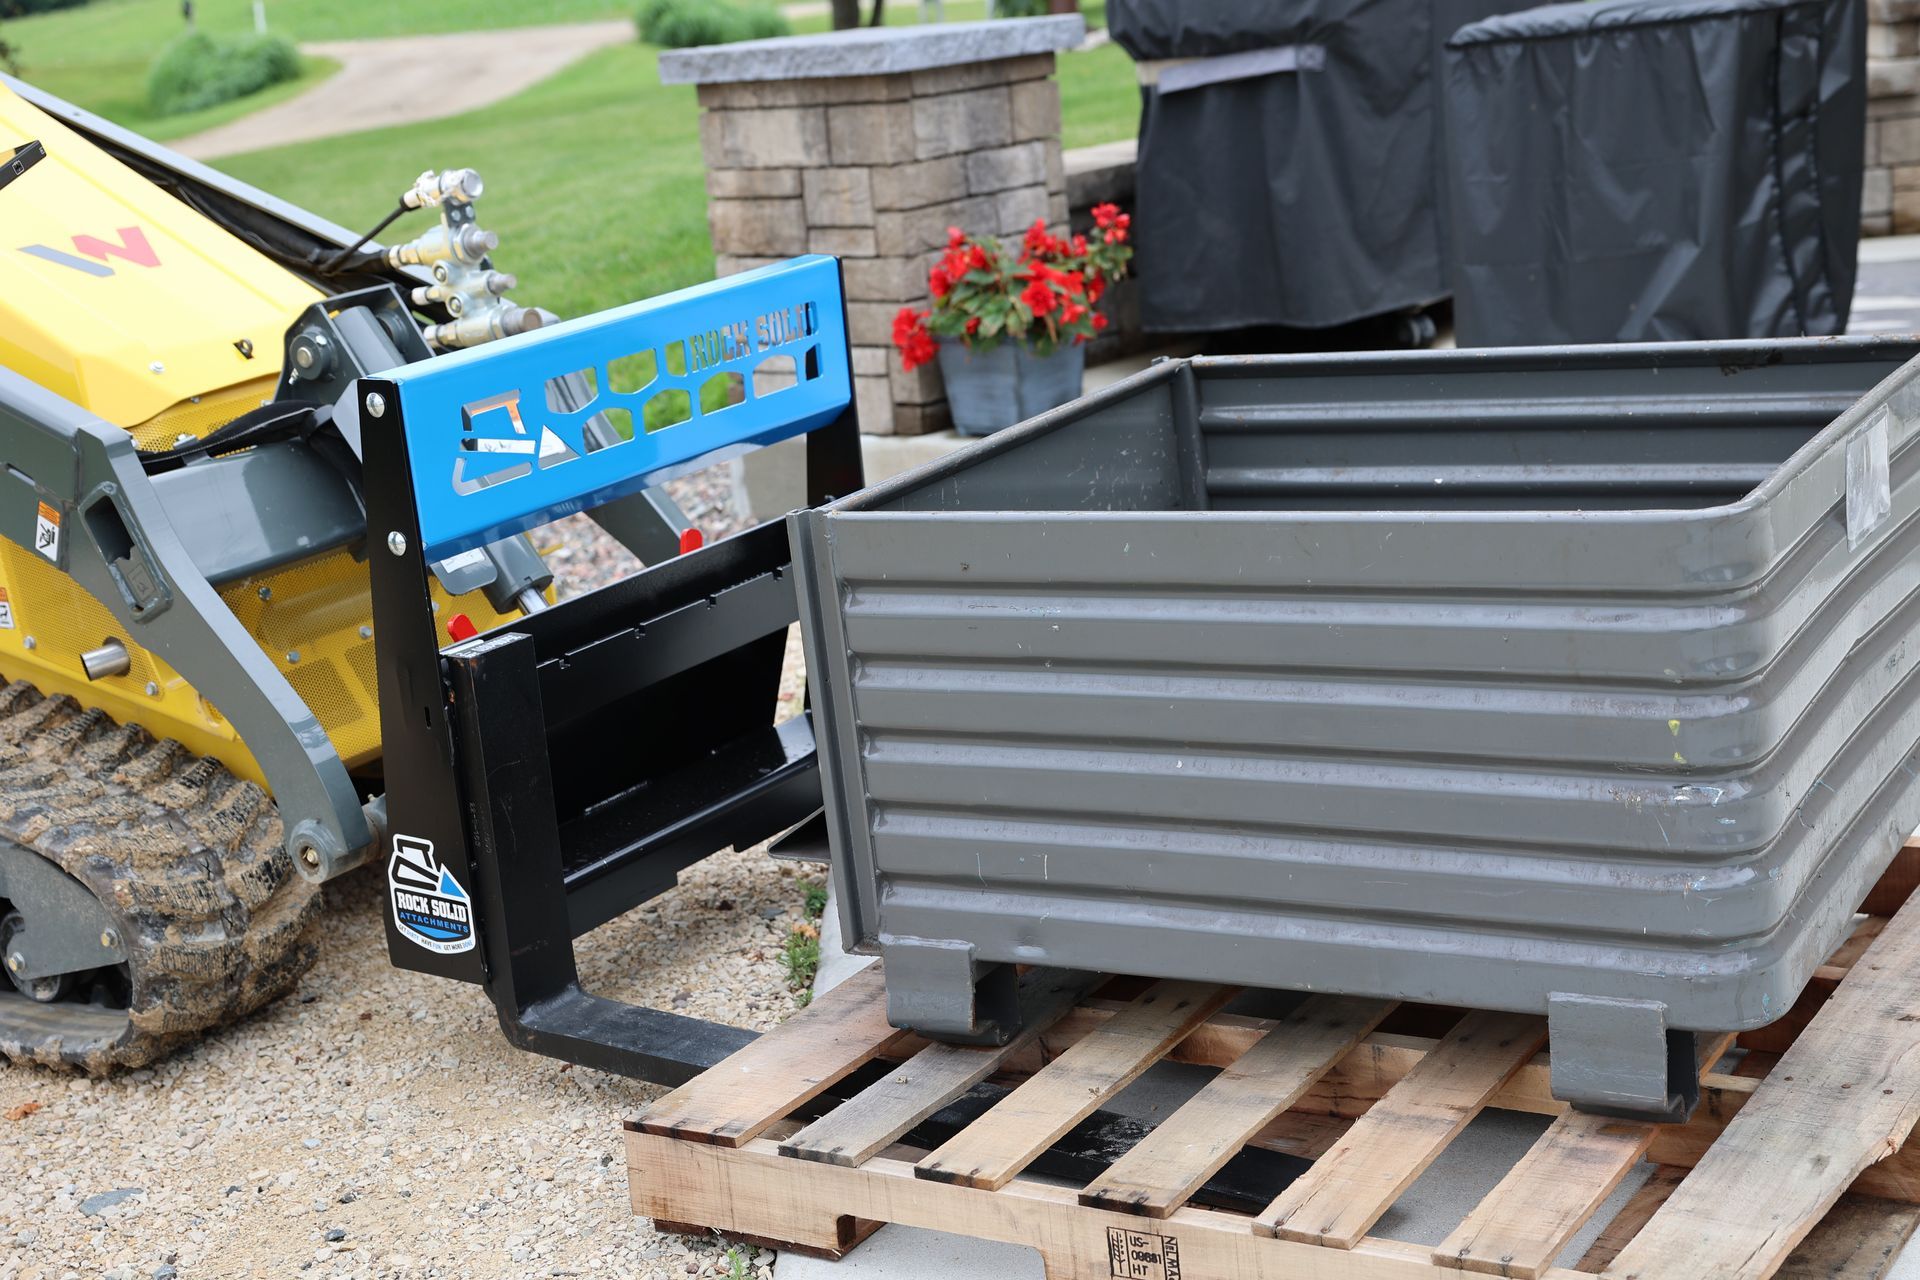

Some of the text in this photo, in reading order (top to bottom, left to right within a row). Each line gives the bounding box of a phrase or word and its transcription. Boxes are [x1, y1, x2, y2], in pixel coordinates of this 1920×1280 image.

[689, 301, 819, 373] ROCK SOLID
[396, 891, 467, 922] ROCK SOLID
[400, 912, 469, 932] ATTACHMENTS
[1129, 1235, 1149, 1248] US-
[1132, 1264, 1149, 1276] HT
